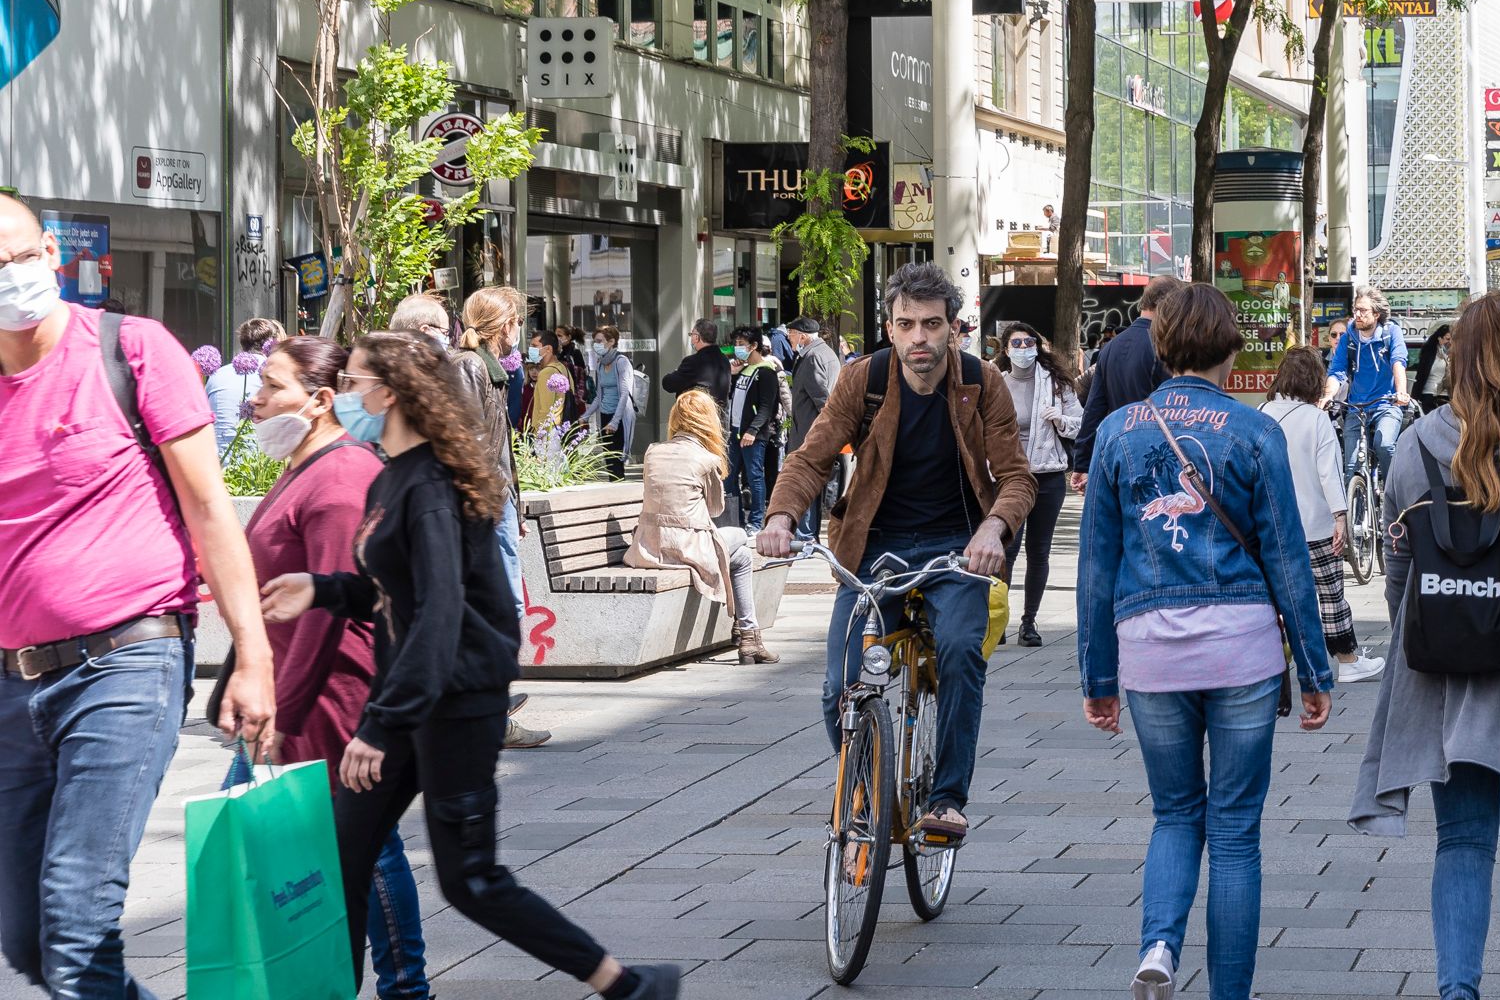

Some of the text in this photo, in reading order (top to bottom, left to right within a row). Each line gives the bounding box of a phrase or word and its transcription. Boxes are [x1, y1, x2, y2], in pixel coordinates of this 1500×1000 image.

[890, 50, 932, 87] comm
[540, 73, 595, 86] SIX
[431, 117, 478, 139] ABAK
[155, 157, 190, 169] EXPLORE IT ON
[155, 171, 201, 195] AppGallery
[894, 204, 934, 230] Sal
[1242, 300, 1281, 310] GOGH
[1236, 311, 1292, 323] CÉZANNE
[1165, 391, 1191, 407] i'm
